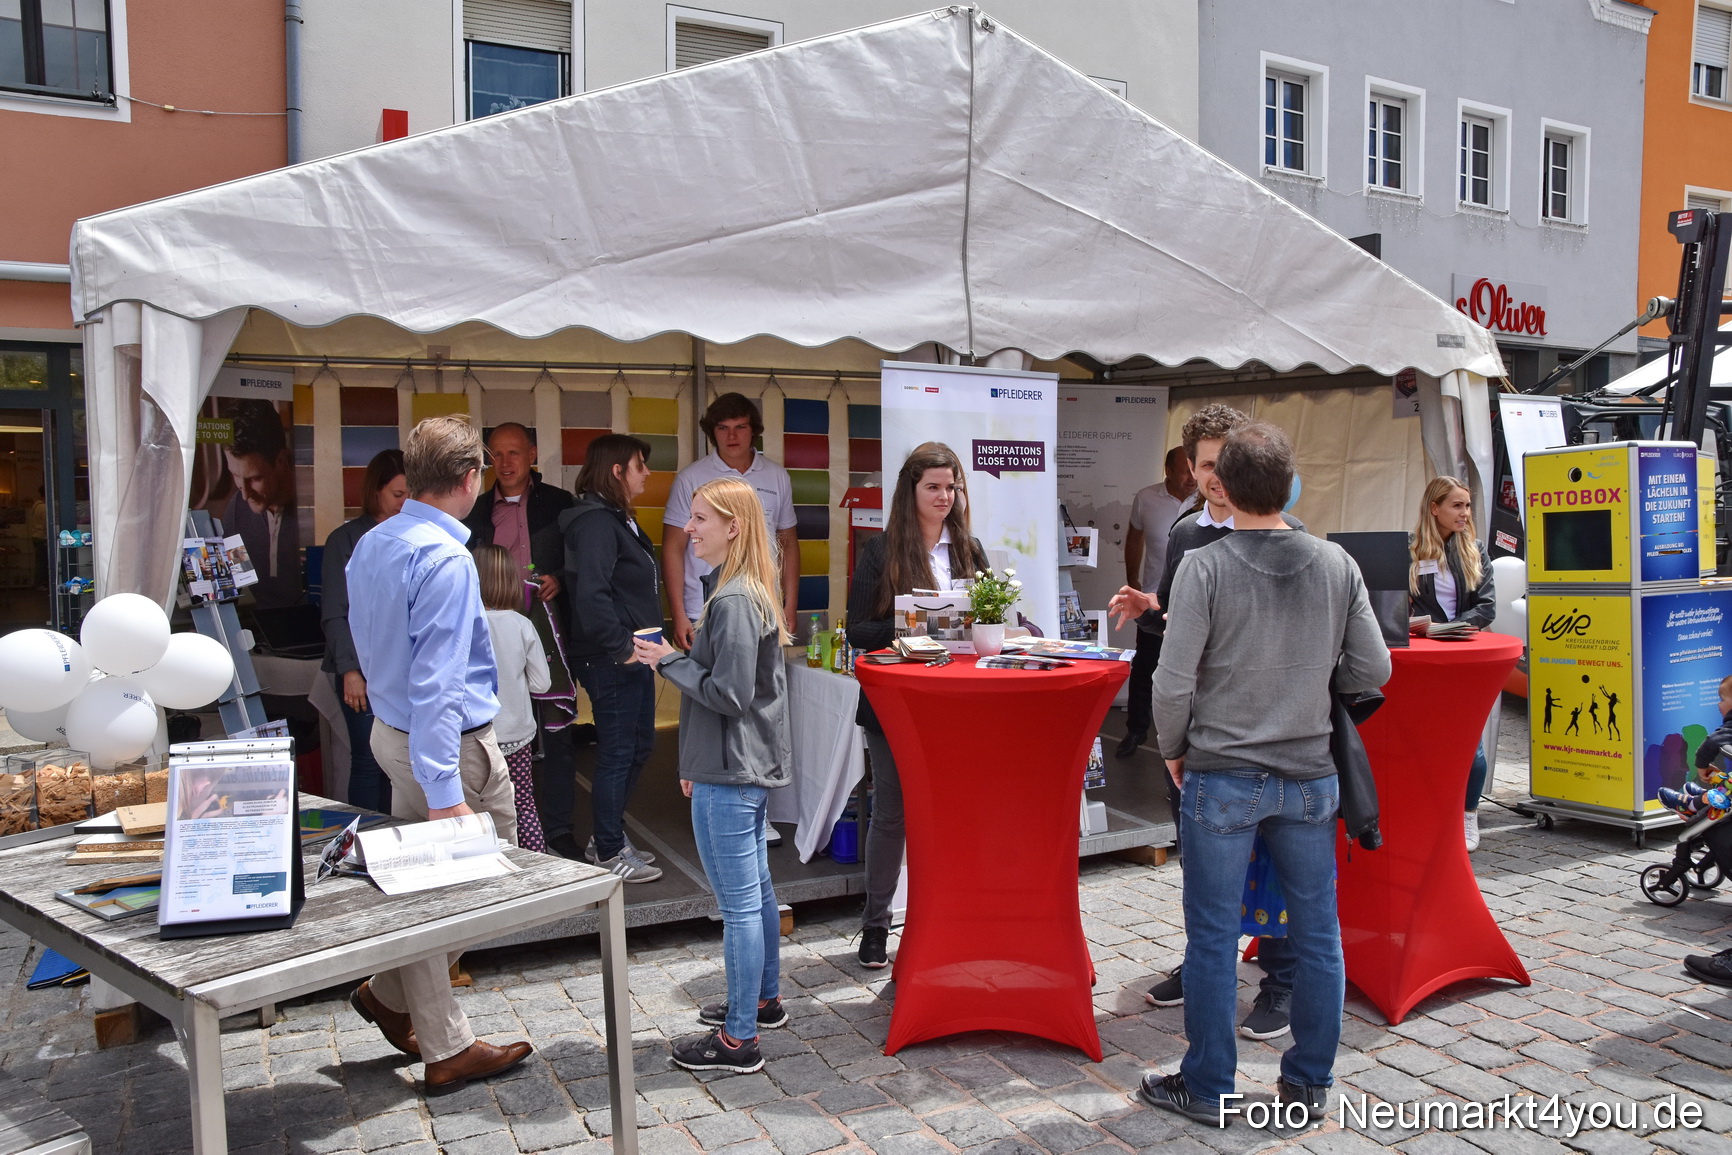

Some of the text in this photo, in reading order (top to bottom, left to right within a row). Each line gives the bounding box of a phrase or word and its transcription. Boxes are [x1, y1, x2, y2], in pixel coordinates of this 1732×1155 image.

[247, 379, 282, 389] PFLEIDERER
[998, 388, 1043, 400] PFLEIDERER
[1121, 396, 1156, 404] PFLEIDERER
[198, 422, 230, 430] RATIONS
[202, 431, 211, 439] TO
[213, 431, 229, 439] YOU
[1059, 431, 1132, 440] LEIDERER GRUPPE
[977, 445, 1042, 456] INSPIRATIONS
[977, 456, 1039, 467] CLOSE TO YOU
[1649, 474, 1686, 485] MIT EINEM
[1529, 487, 1621, 508] FOTOBOX
[1647, 486, 1688, 498] LÄCHELN IN
[1645, 499, 1691, 512] DIE ZUKUNFT
[1652, 512, 1686, 524] STARTEN!
[1577, 659, 1605, 667] BEWEGT
[1543, 744, 1623, 759] www.kjr-neumarkt.de
